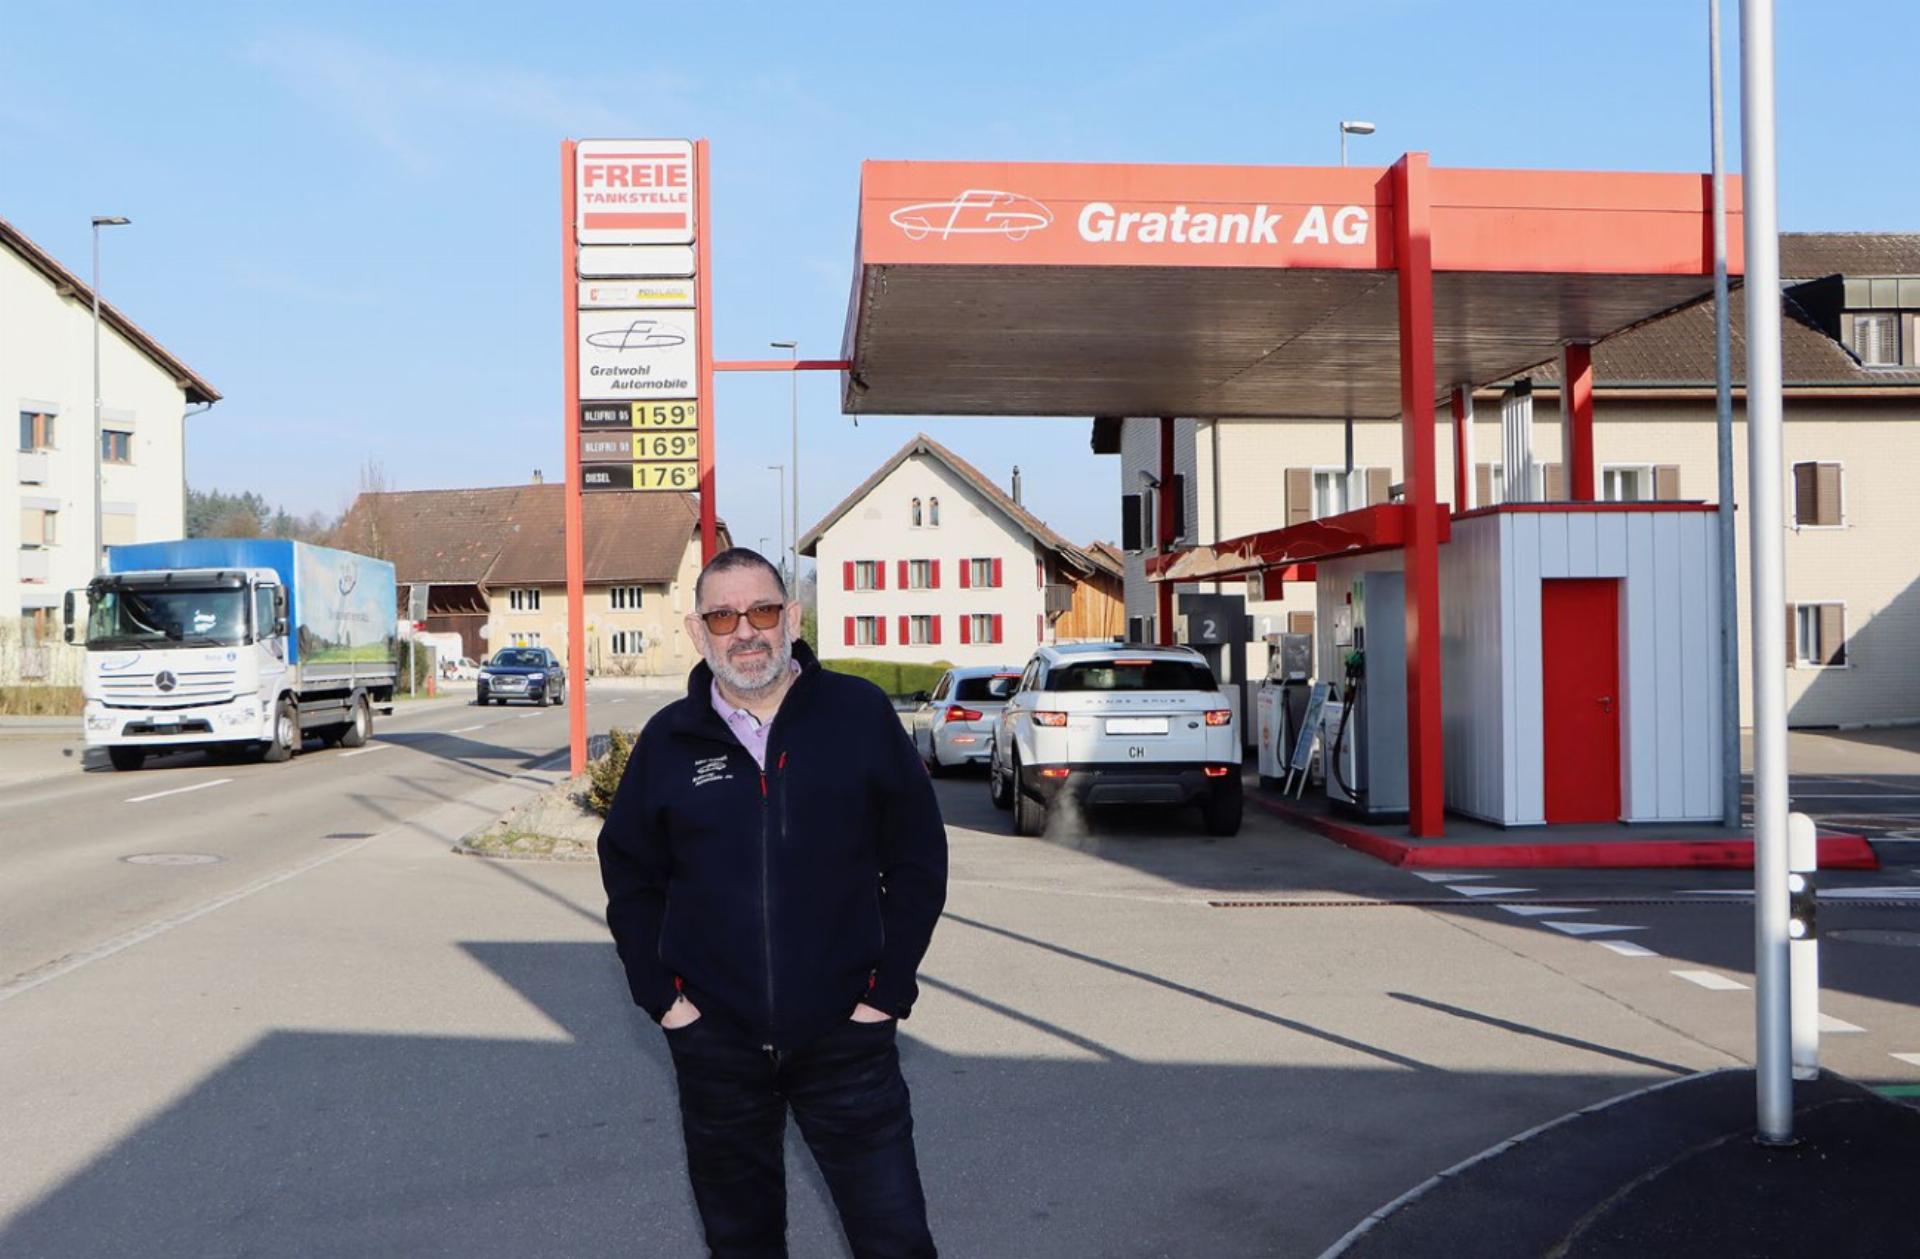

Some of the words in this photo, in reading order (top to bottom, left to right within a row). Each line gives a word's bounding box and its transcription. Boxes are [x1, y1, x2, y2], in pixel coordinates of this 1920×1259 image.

[583, 164, 687, 188] FREIE
[584, 192, 688, 204] TANKSTELLE
[1077, 202, 1282, 244] Gratank
[1292, 204, 1369, 245] AG
[590, 365, 651, 376] Gratwohl
[610, 379, 688, 390] Automobile
[1202, 619, 1217, 639] 2
[1128, 746, 1145, 758] CH
